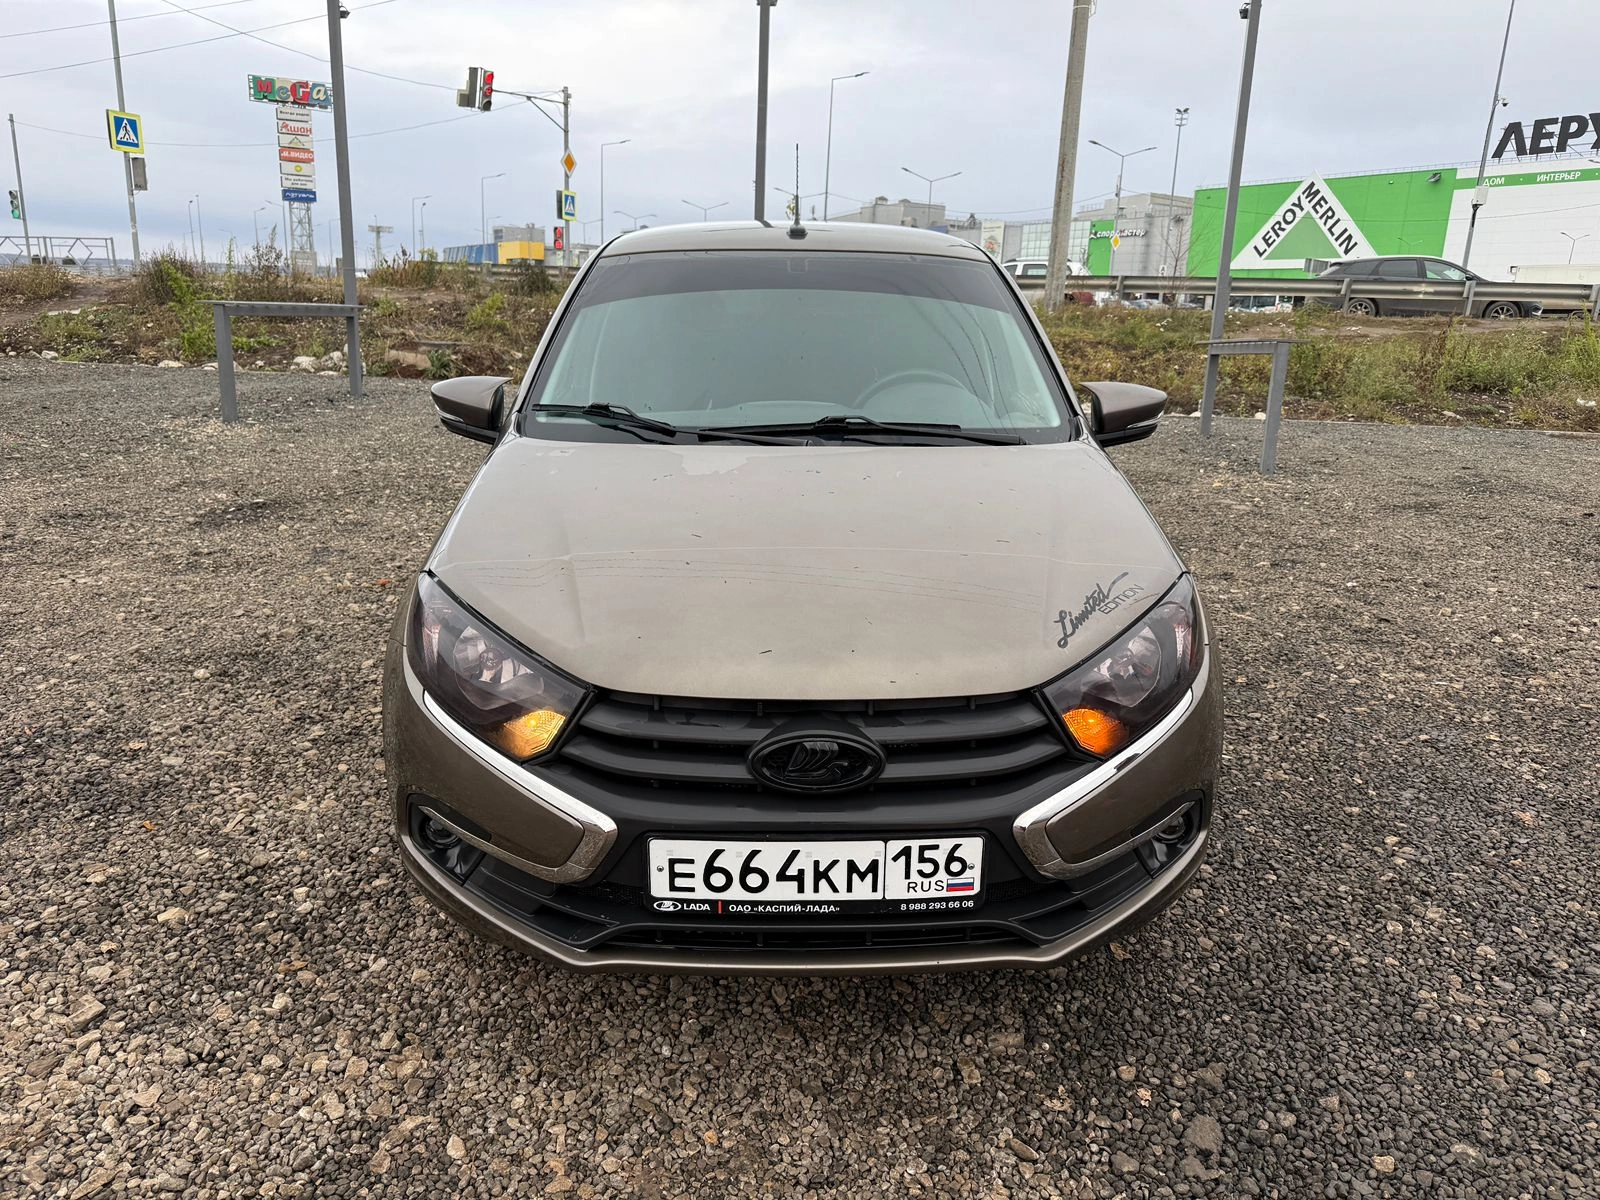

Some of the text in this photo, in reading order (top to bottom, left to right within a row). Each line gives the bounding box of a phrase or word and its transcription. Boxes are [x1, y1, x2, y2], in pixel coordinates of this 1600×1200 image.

[1483, 171, 1581, 187] ДОМ ИНТЕРЬЕР
[1253, 181, 1358, 258] LEROY MERLIN
[1097, 583, 1145, 615] EDITION
[1053, 571, 1129, 649] Limited
[668, 844, 968, 894] Е664КМ 156
[907, 880, 945, 893] RUS
[683, 903, 711, 911] LADA
[753, 903, 840, 913] «КАСПИЙ-ЛАДА»
[928, 902, 947, 910] 293
[948, 901, 960, 909] 66
